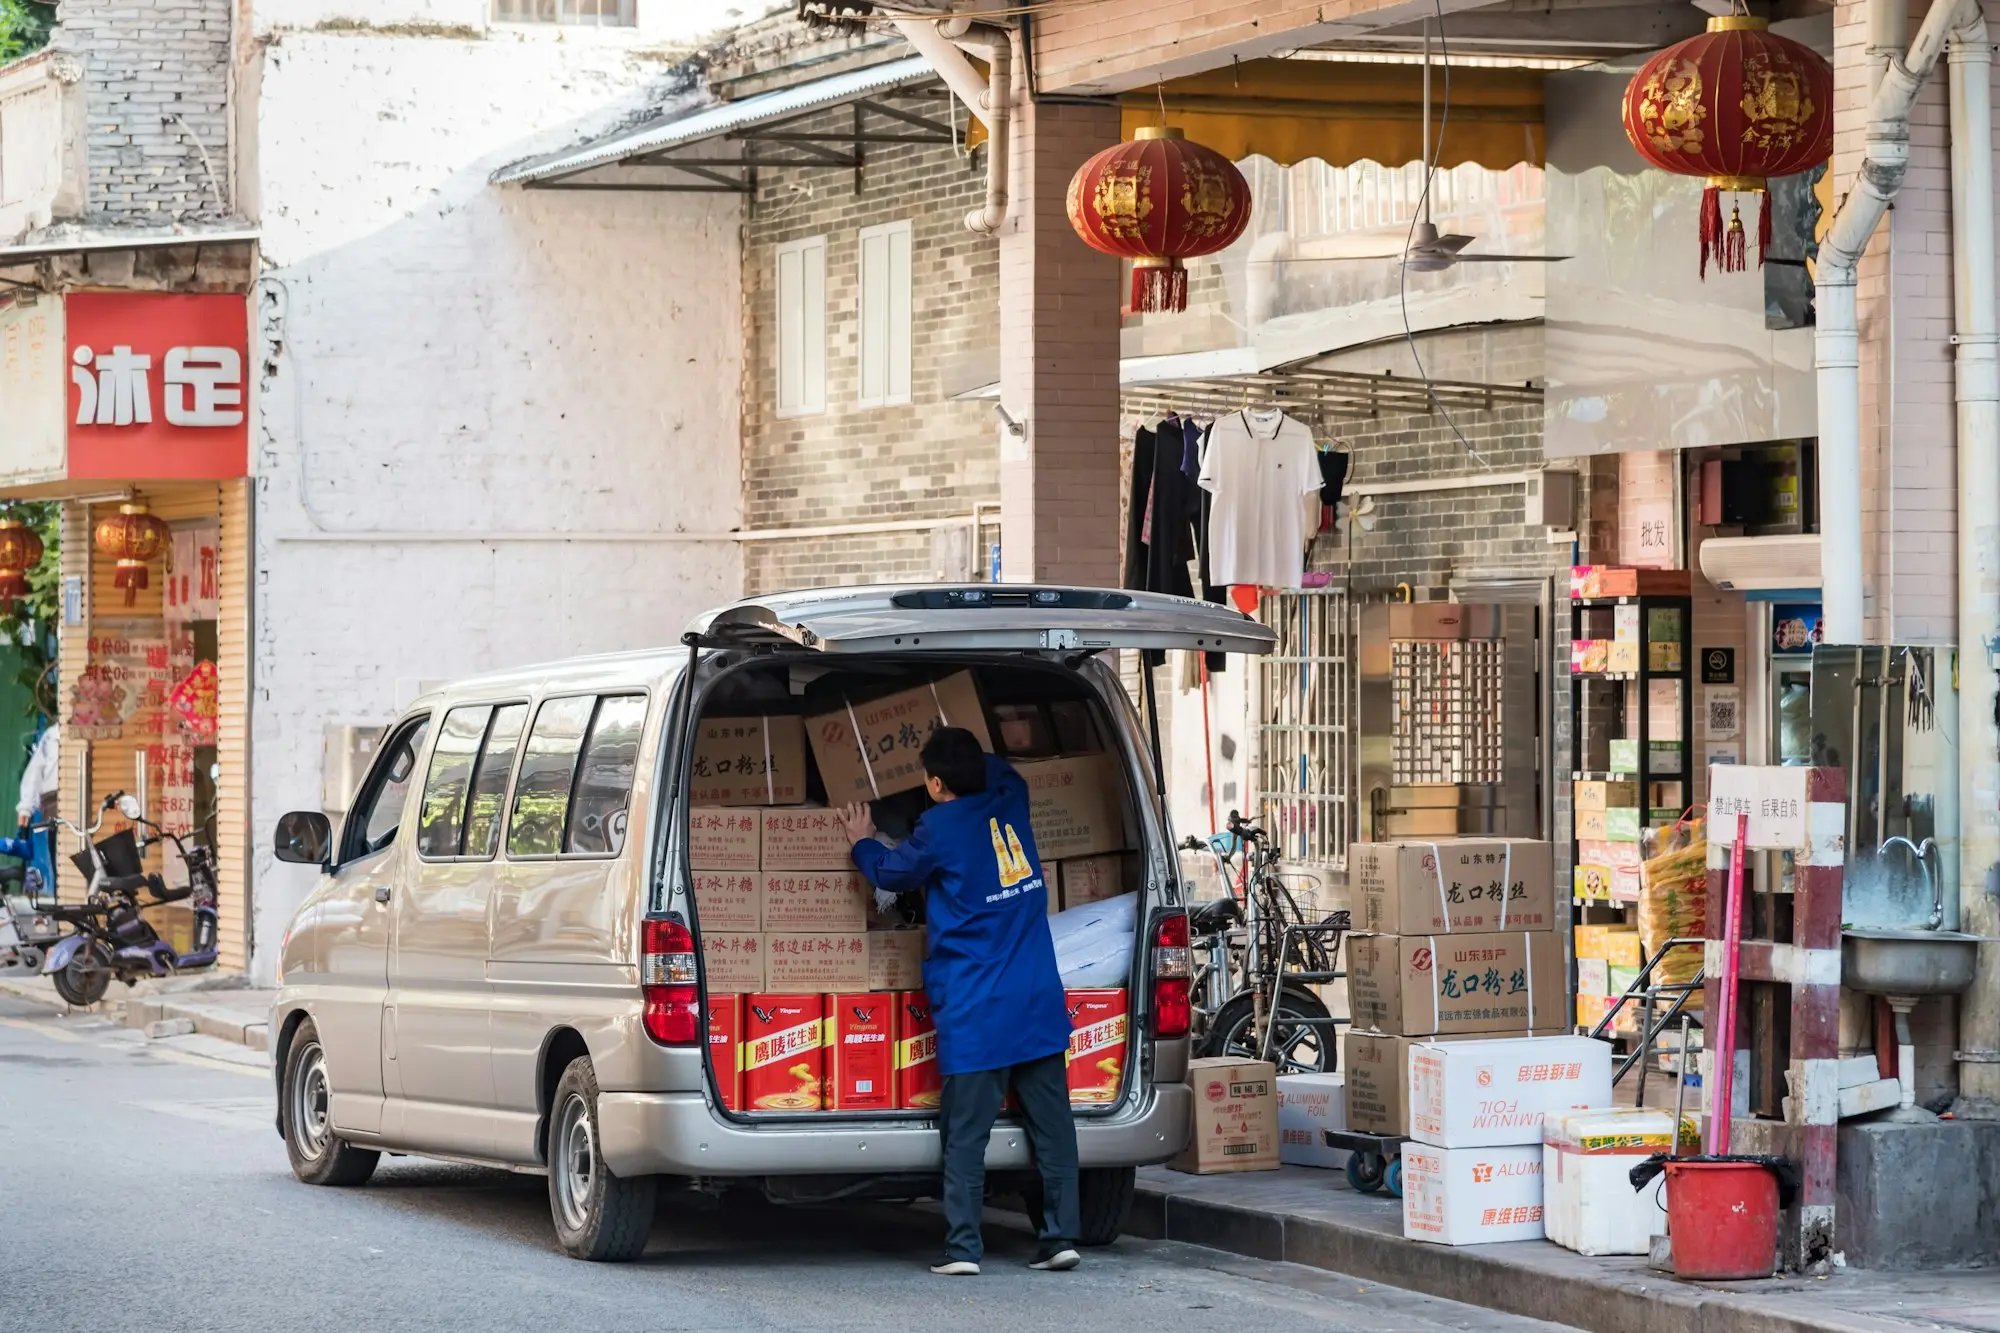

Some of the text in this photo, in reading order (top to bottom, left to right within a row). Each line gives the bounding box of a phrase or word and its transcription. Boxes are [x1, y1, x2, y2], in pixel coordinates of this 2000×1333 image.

[72, 345, 243, 426] 沐足
[1640, 520, 1665, 547] 批发
[1714, 795, 1798, 819] 禁止停车 后果自负
[1460, 853, 1507, 865] 山东特产
[1447, 880, 1528, 904] 龙口粉丝
[1454, 949, 1507, 962] 山东特产
[1441, 967, 1529, 999] 龙口粉丝
[1517, 1062, 1582, 1082] 康维铝箔
[1286, 1093, 1330, 1105] ALUMINUM
[1479, 1099, 1518, 1114] FOIL
[1307, 1105, 1327, 1117] FOIL
[1481, 1206, 1543, 1226] 康维铝箔
